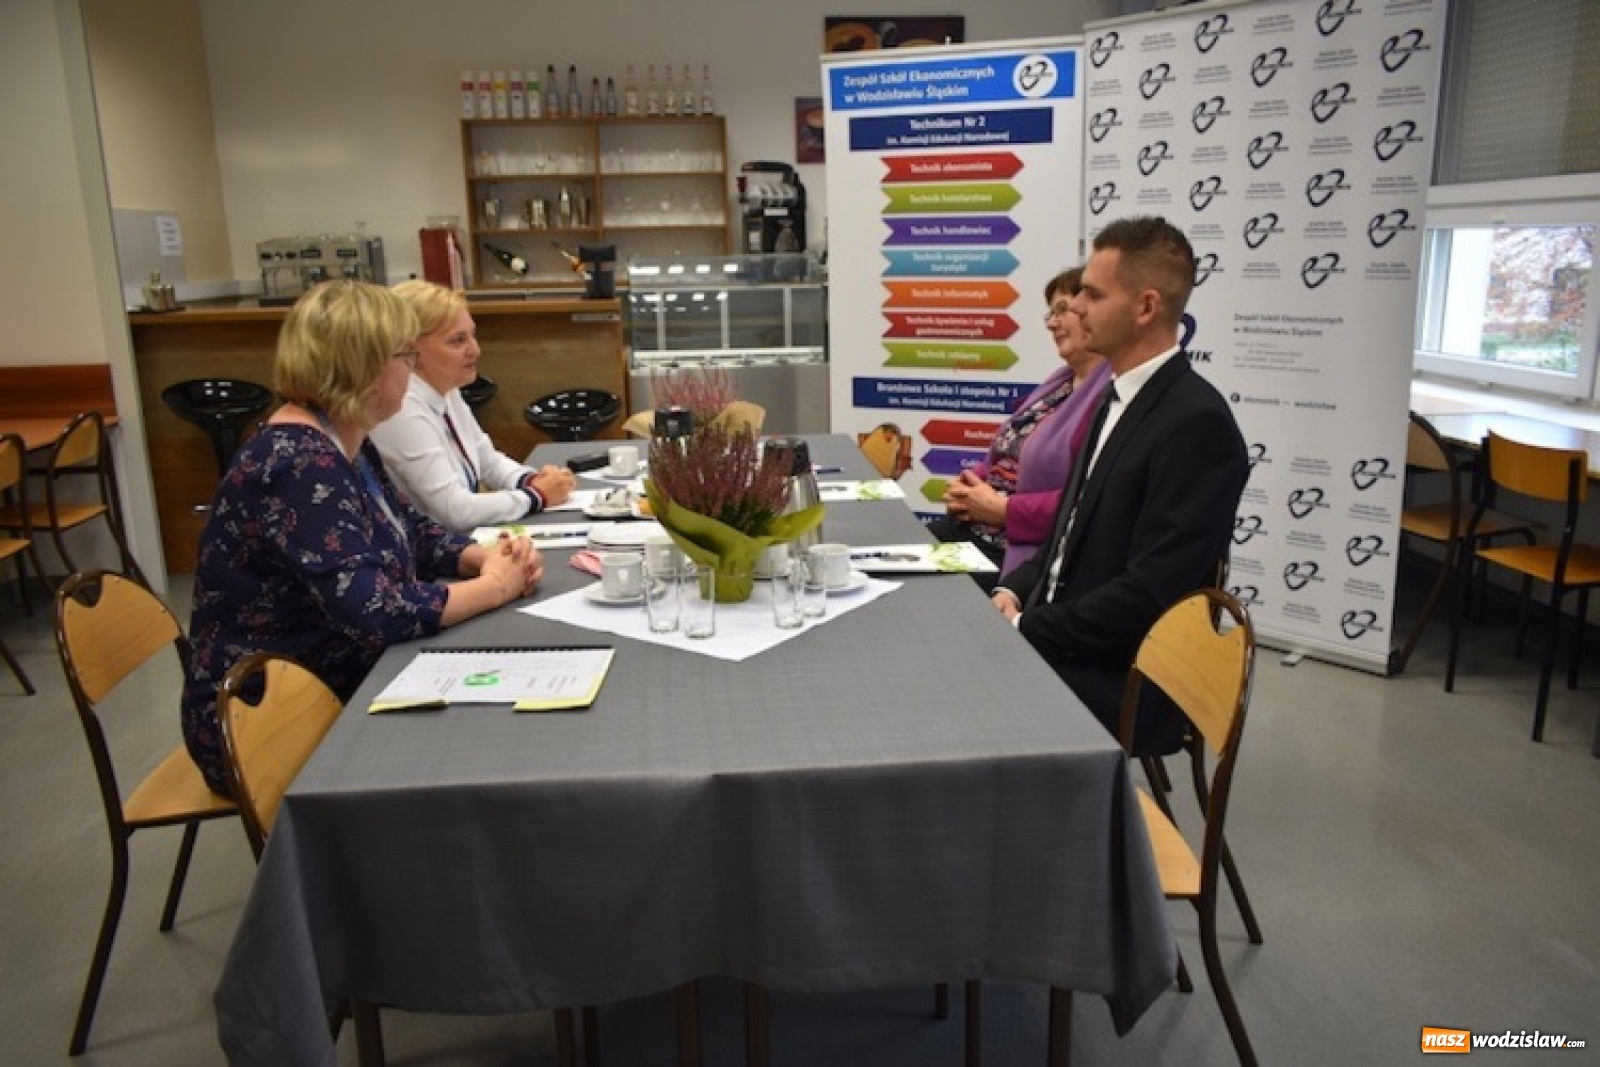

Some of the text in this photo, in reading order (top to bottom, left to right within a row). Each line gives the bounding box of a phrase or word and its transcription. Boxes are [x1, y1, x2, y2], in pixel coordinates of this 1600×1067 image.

[843, 65, 995, 88] Zespół Szkół Ekonomicznych
[926, 84, 969, 100] Śląskim
[909, 115, 986, 130] Technikum Nr 2
[911, 225, 941, 236] Technik
